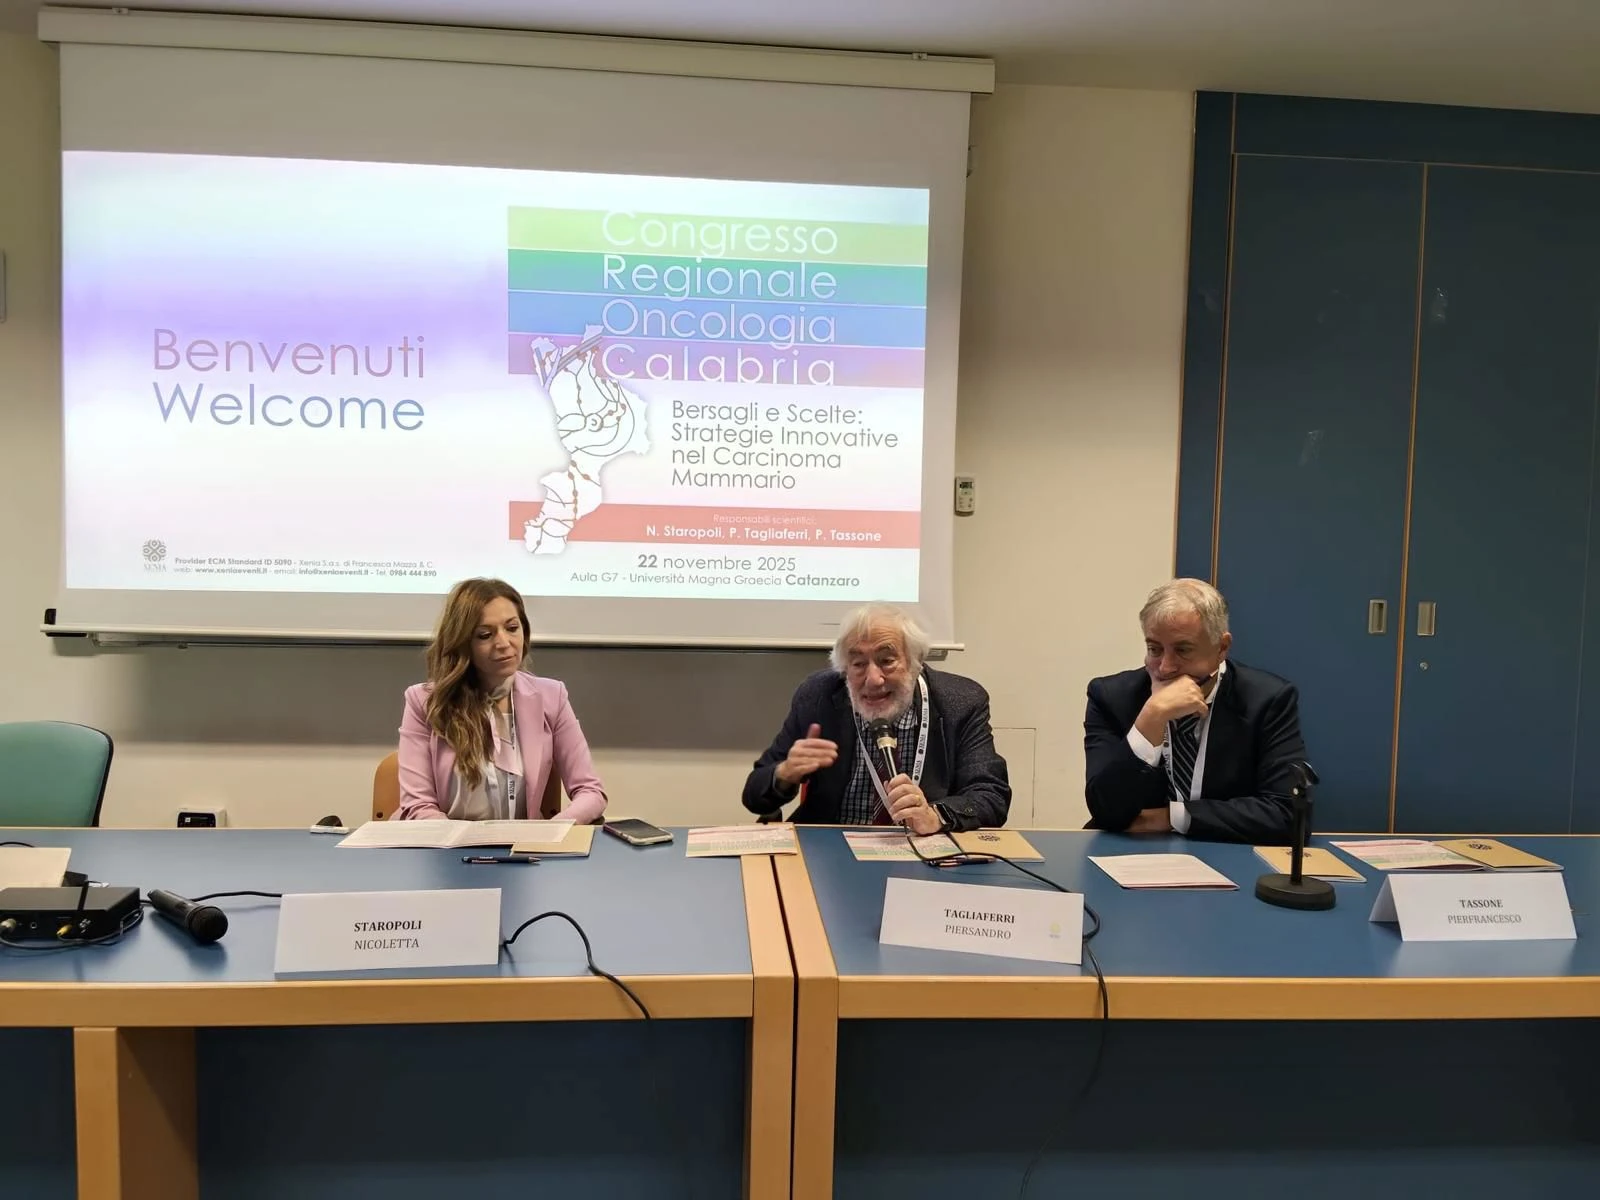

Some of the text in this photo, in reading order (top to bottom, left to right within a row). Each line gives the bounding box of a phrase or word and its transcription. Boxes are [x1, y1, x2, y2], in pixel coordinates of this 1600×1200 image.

[602, 210, 838, 257] Congresso
[602, 254, 837, 301] Regionale
[602, 299, 836, 350] Oncologia
[153, 328, 425, 378] Benvenuti
[602, 343, 835, 385] Calabria
[152, 381, 425, 431] Welcome
[672, 400, 864, 426] Bersagli e Scelte:
[671, 423, 898, 448] Strategie Innovative
[671, 446, 842, 469] nel Carcinoma
[671, 469, 796, 490] Mammario
[646, 525, 882, 543] N. Staropoli, P. Tagliaferri, P. Tassone
[175, 557, 206, 565] Provider
[208, 557, 226, 565] ECM
[228, 558, 262, 566] Standard
[352, 561, 392, 569] Francesca
[637, 554, 796, 572] 22 novembre 2025
[423, 570, 437, 578] 890
[570, 571, 598, 583] Aula
[600, 572, 619, 583] G7
[629, 571, 685, 585] Università
[688, 574, 731, 588] Magna
[734, 574, 782, 587] Graecia
[786, 573, 860, 588] Catanzaro
[1459, 899, 1503, 909] TASSONE
[943, 908, 1015, 924] TAGLIAFERRI
[1447, 913, 1522, 925] PIERFRANCESCO
[353, 920, 423, 932] STAROPOLI
[944, 924, 1012, 940] PIERSANDRO
[353, 938, 420, 950] NICOLETTA
